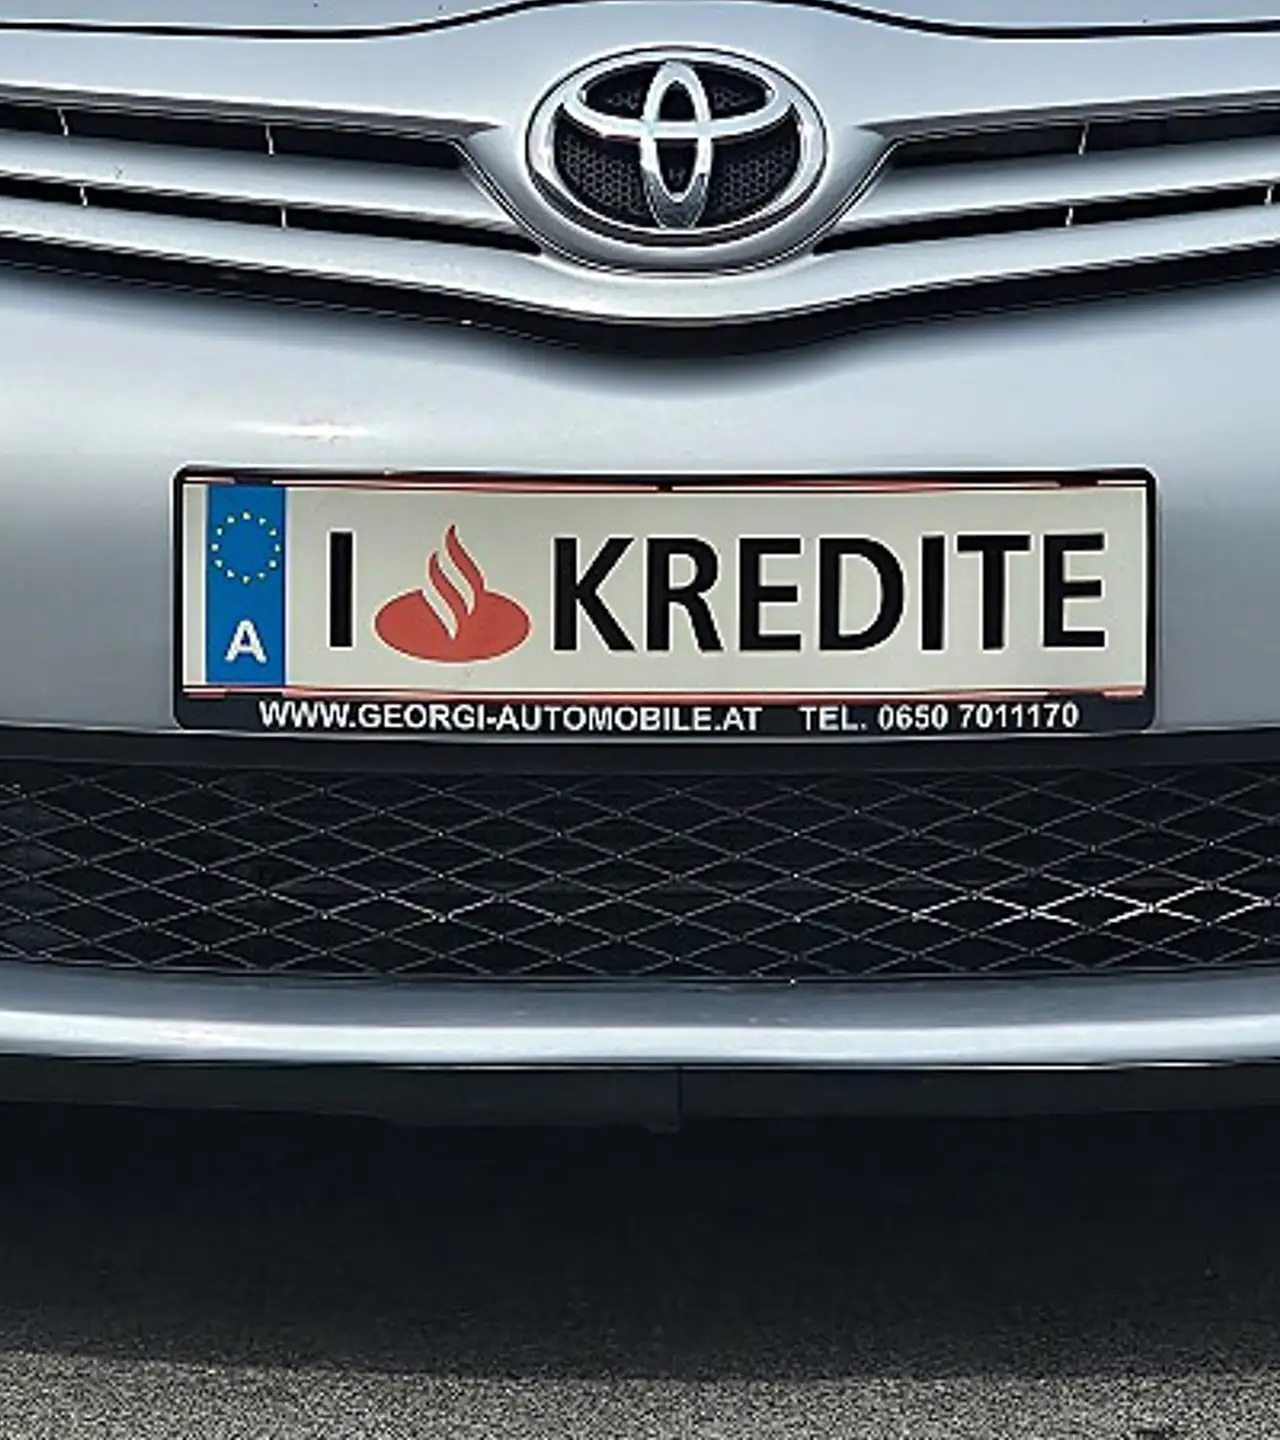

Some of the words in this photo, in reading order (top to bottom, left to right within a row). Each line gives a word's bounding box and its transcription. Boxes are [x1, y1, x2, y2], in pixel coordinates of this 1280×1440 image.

[329, 530, 354, 648] I
[552, 533, 1106, 651] KREDITE
[224, 619, 268, 663] A
[259, 700, 763, 731] WWW.GEORGI-AUTOMOBILE.AT
[799, 705, 868, 731] TEL.
[877, 703, 949, 731] 0650
[959, 701, 1080, 729] 7011170
